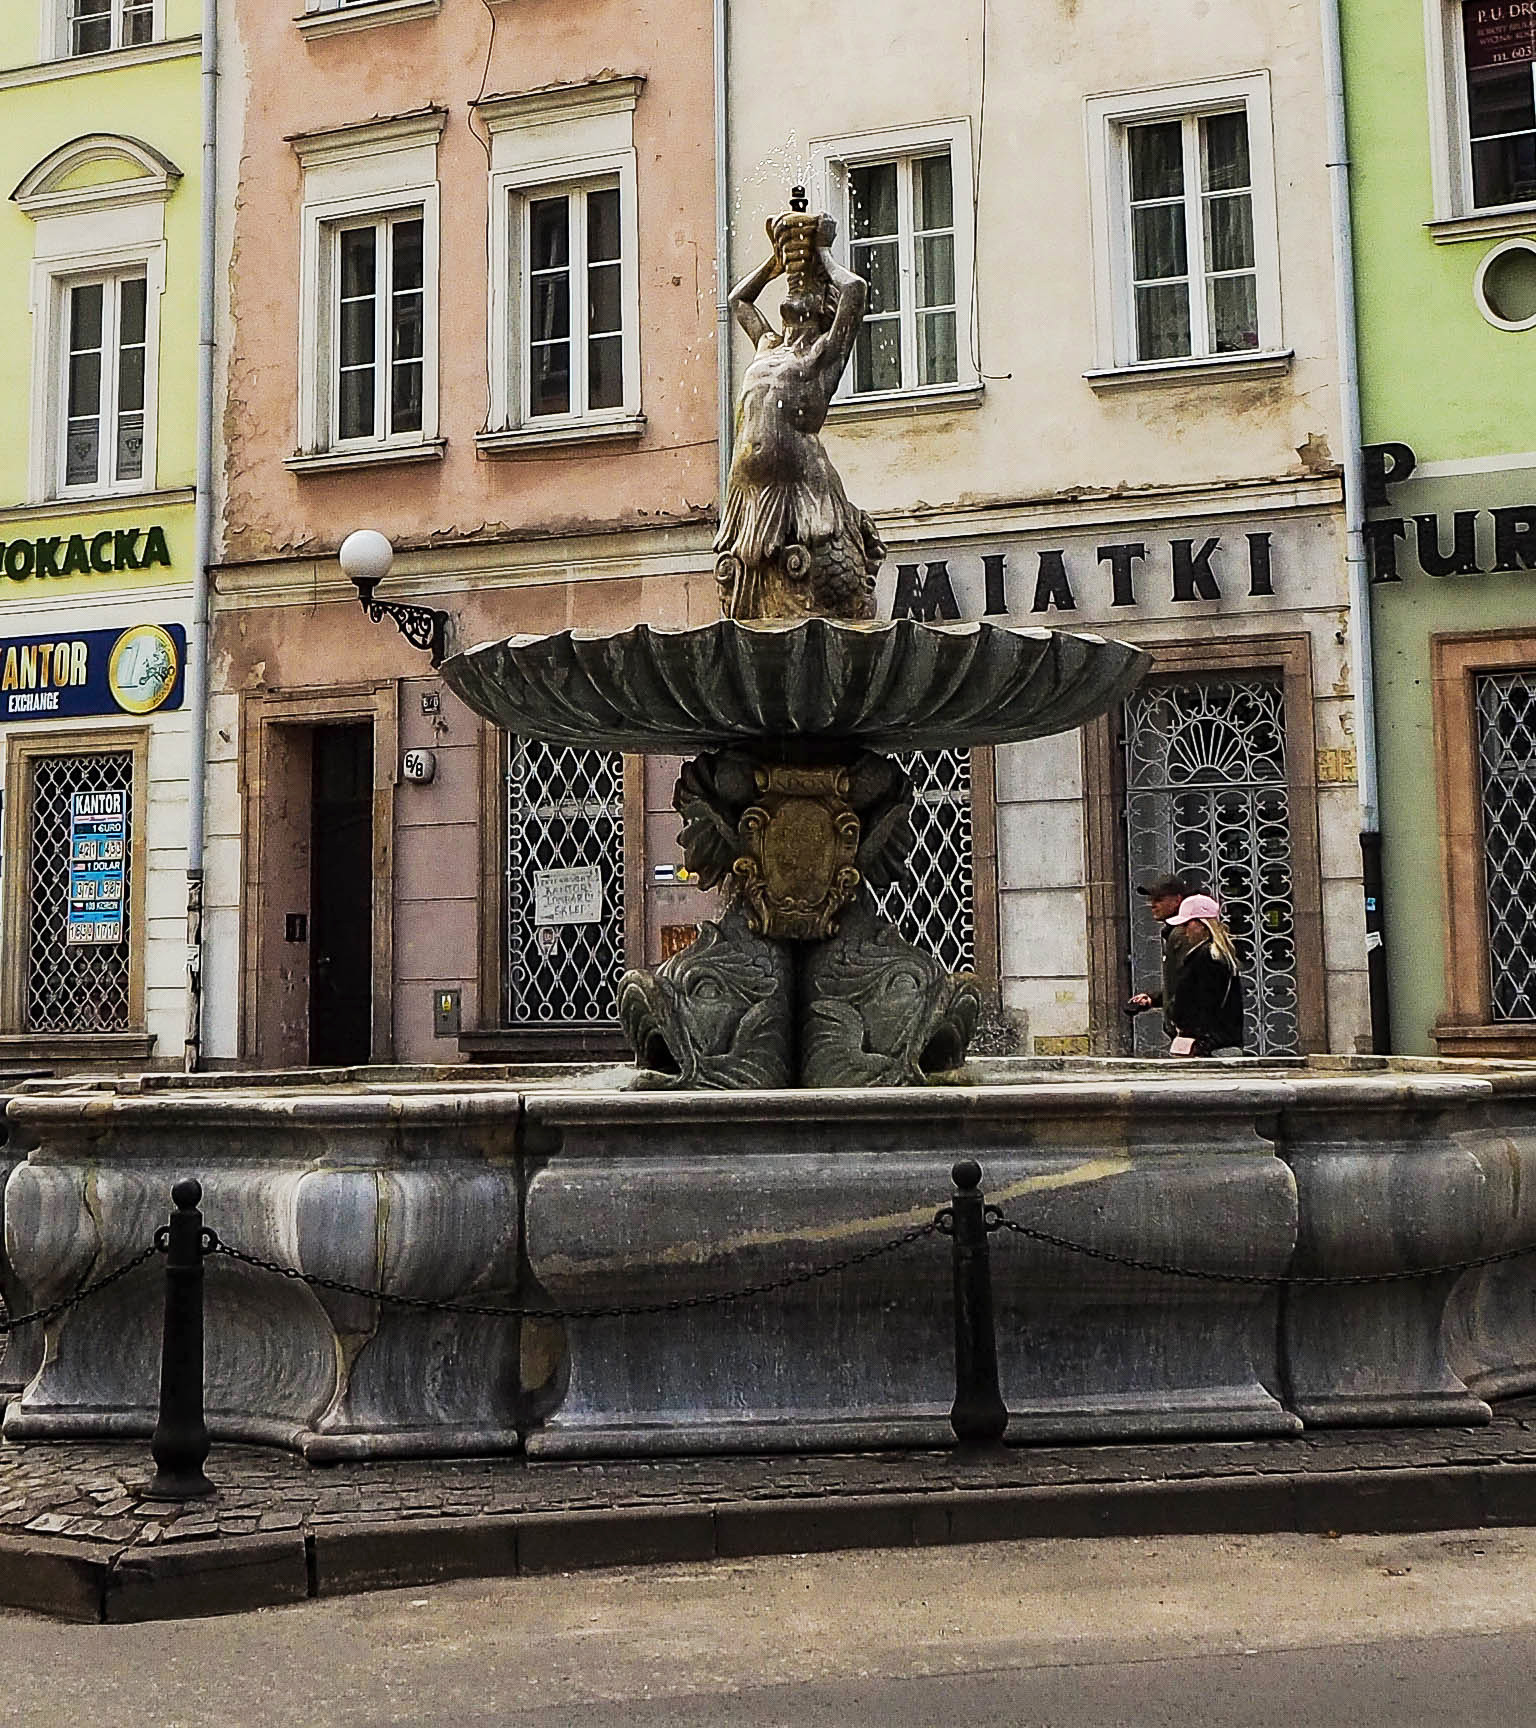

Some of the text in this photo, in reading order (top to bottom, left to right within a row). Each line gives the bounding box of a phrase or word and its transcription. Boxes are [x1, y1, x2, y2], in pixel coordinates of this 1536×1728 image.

[1511, 46, 1532, 59] 603
[8, 691, 60, 713] EXCHANGE
[406, 754, 424, 777] 6/8
[75, 793, 121, 815] KANTOR
[92, 861, 121, 871] DOLAR
